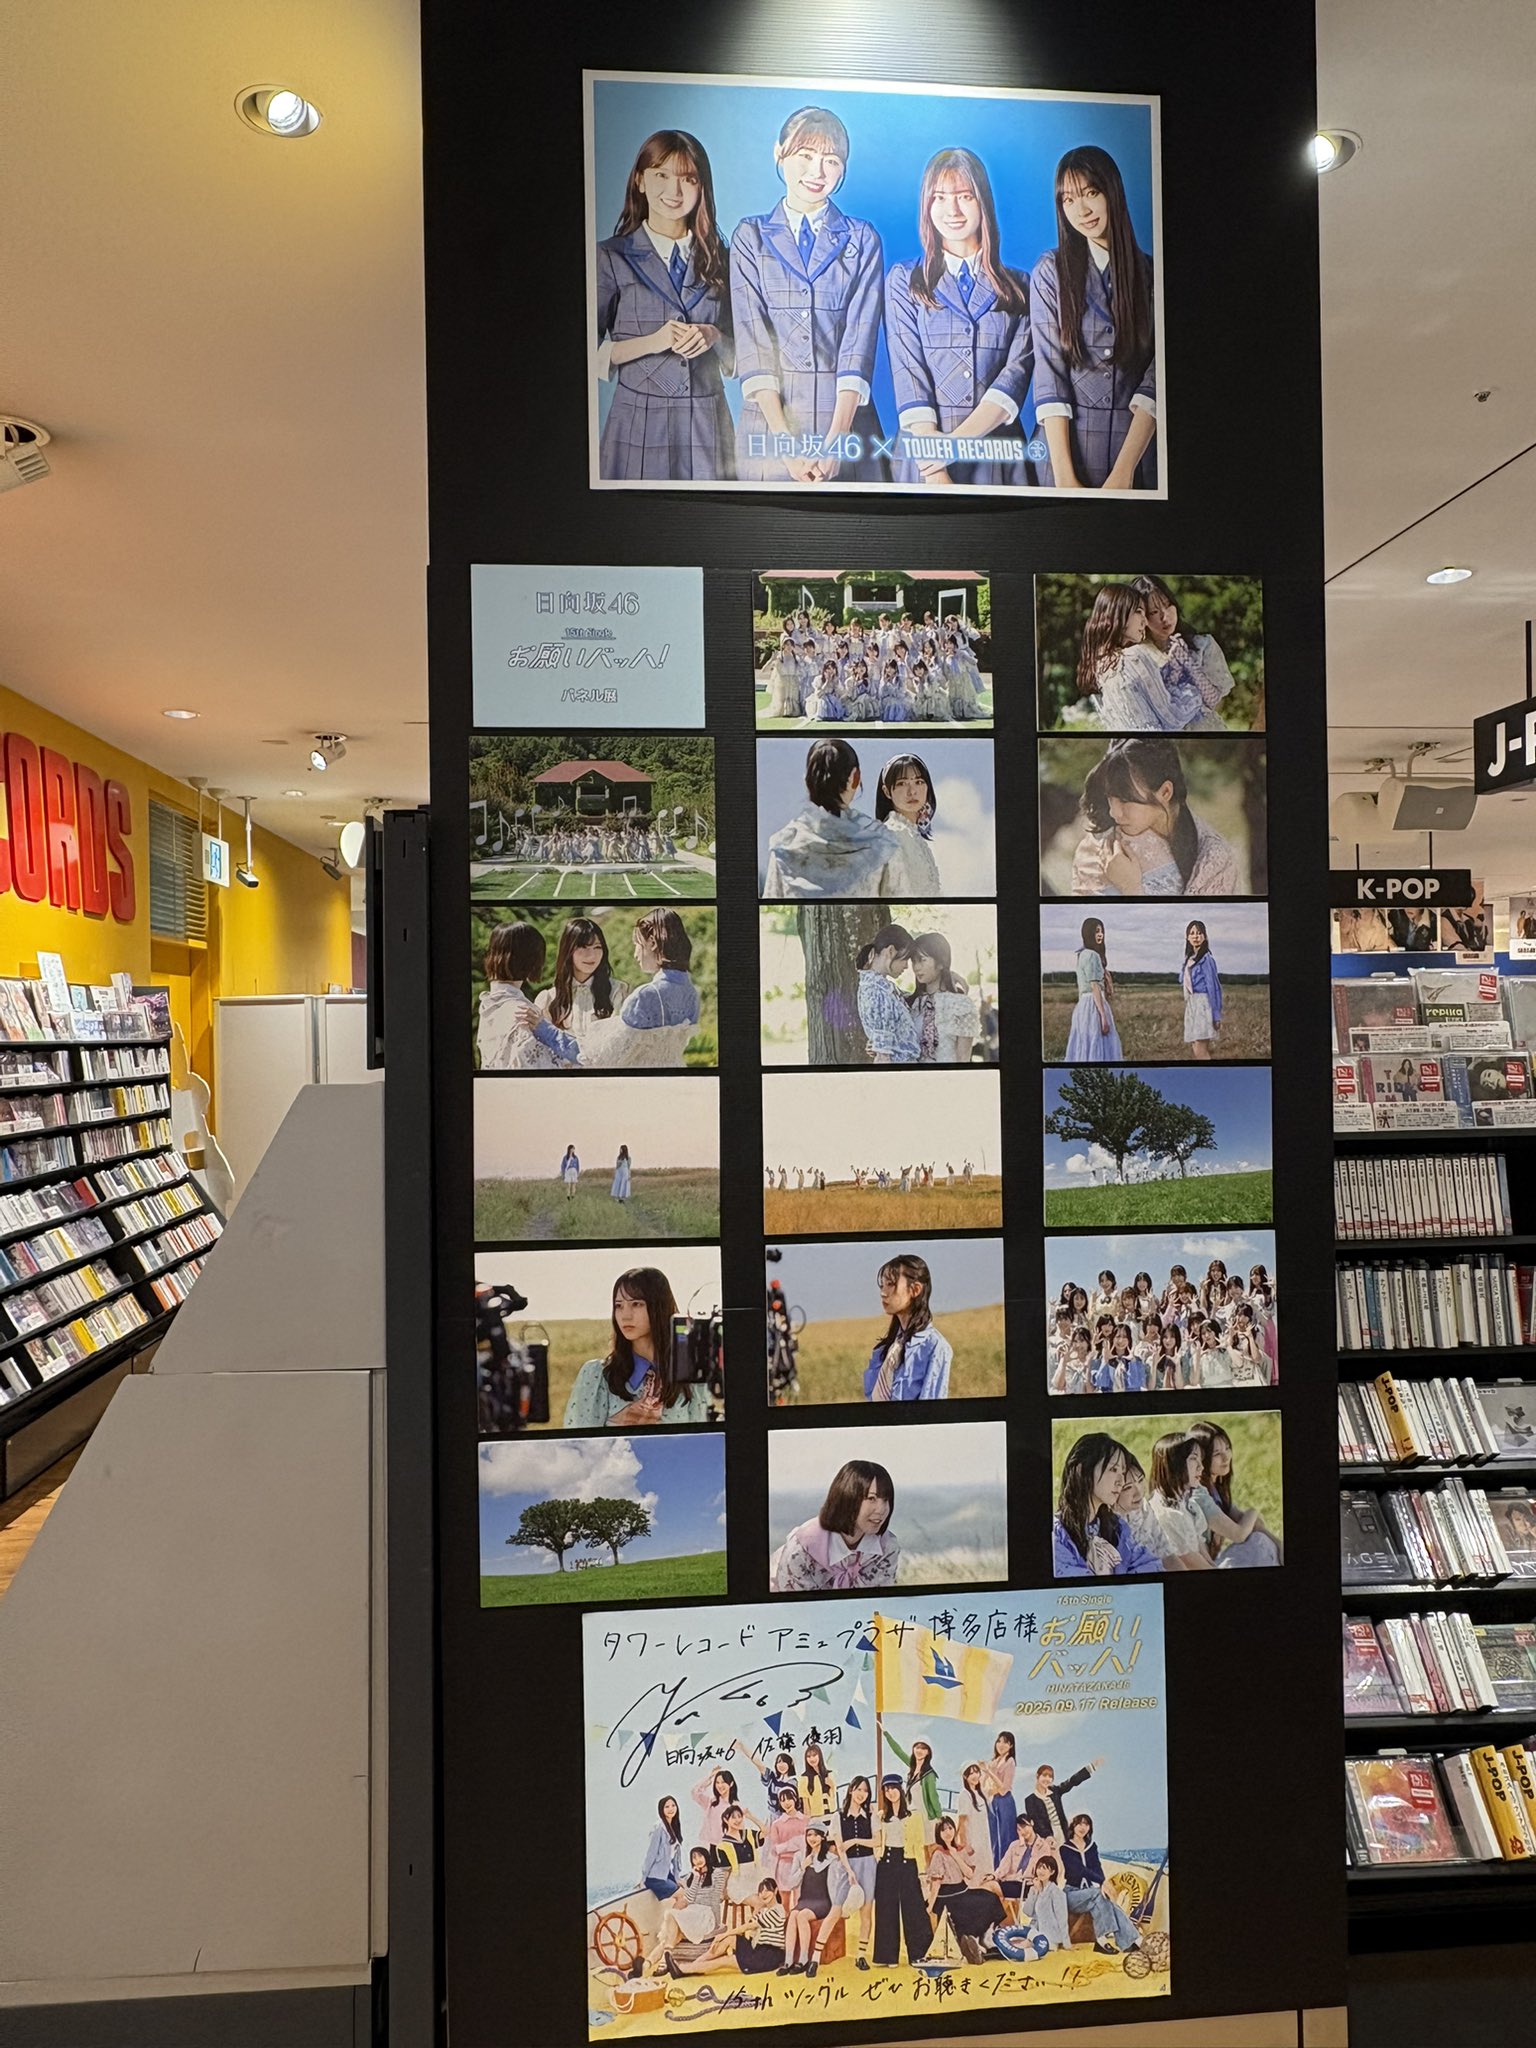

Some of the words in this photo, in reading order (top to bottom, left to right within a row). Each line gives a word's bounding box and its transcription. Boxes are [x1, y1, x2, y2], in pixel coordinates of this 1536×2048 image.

[747, 433, 862, 460] 日向坂46
[902, 437, 954, 459] TOWER
[959, 438, 1024, 460] RECORDS
[536, 591, 641, 616] 日向坂46
[507, 642, 671, 669] お願いバッハ!
[560, 687, 618, 703] パネル展
[1356, 878, 1441, 901] K-POP
[1381, 1377, 1399, 1414] J-POP
[929, 1608, 1039, 1646] 博多店様
[1039, 1609, 1141, 1647] お願い
[1027, 1640, 1142, 1680] バッハ!
[1015, 1700, 1095, 1715] 2025.09.17
[1099, 1697, 1157, 1711] Release
[1483, 1752, 1507, 1802] J-POP
[1511, 1750, 1535, 1800] J-POP
